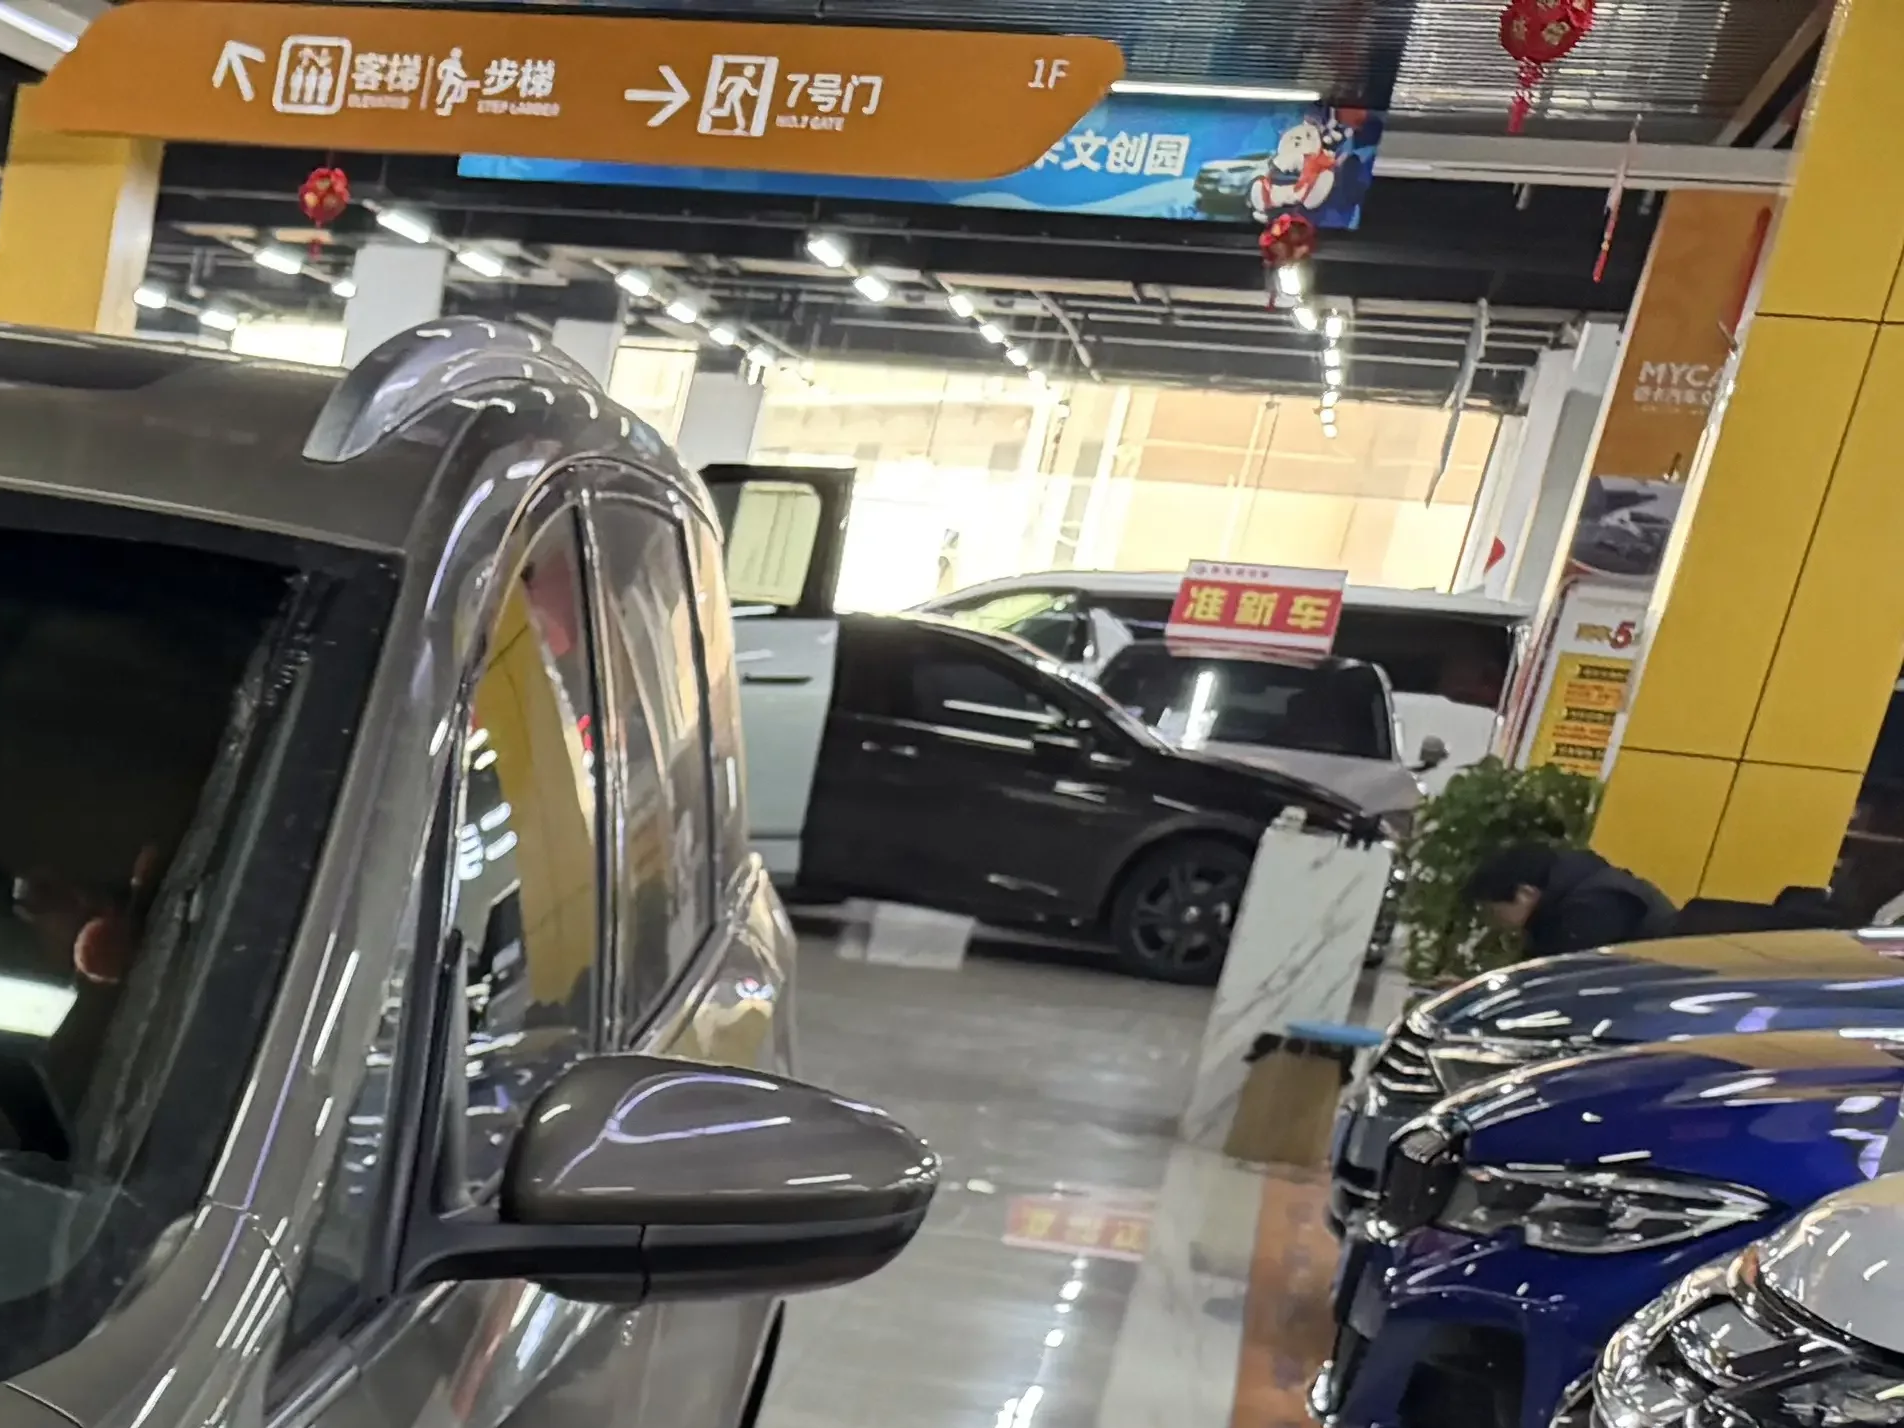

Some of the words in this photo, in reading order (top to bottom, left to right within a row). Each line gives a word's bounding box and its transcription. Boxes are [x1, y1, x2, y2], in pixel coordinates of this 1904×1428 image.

[481, 57, 556, 98] 步梯
[786, 73, 884, 116] 7号门
[1027, 58, 1070, 89] 1F
[1182, 587, 1332, 630] 准新车
